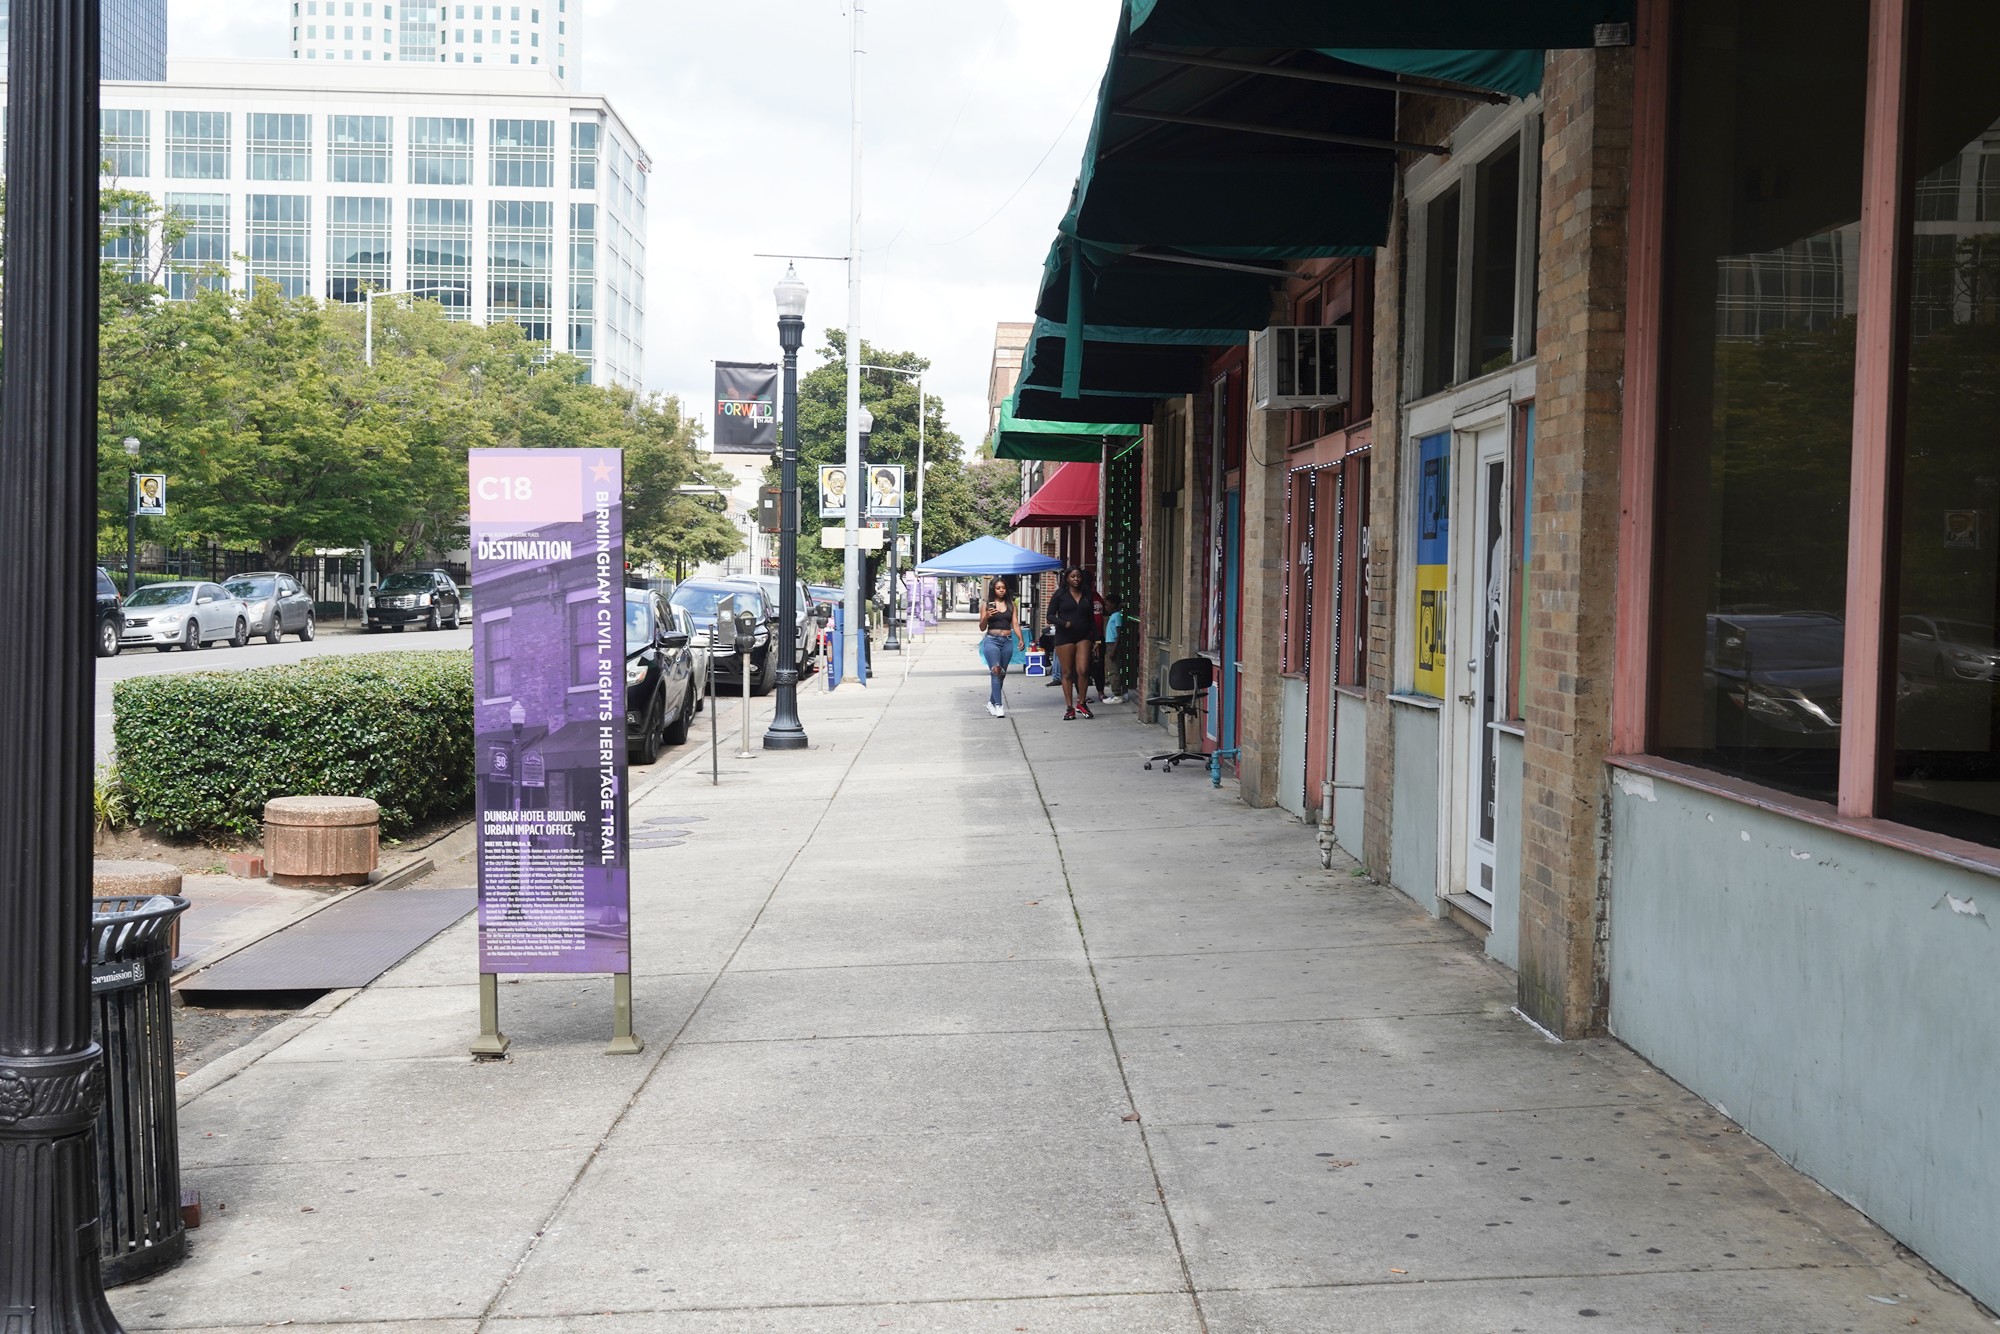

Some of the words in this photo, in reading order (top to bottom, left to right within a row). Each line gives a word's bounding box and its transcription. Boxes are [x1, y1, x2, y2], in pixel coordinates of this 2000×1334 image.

[477, 476, 533, 501] C18
[478, 540, 572, 560] DESTINATION
[596, 491, 611, 604] BIRMINGHAM
[597, 609, 611, 655] CIVIL
[598, 659, 613, 722] RIGHTS
[599, 726, 614, 810] HERITAGE
[484, 810, 519, 822] DUNBAR
[520, 810, 546, 822] HOTEL
[547, 810, 586, 822] BUILDING
[484, 824, 515, 836] URBAN
[515, 824, 544, 836] IMPACT
[545, 824, 576, 837] OFFICE,
[600, 815, 615, 865] TRAIL
[92, 970, 132, 984] ommission
